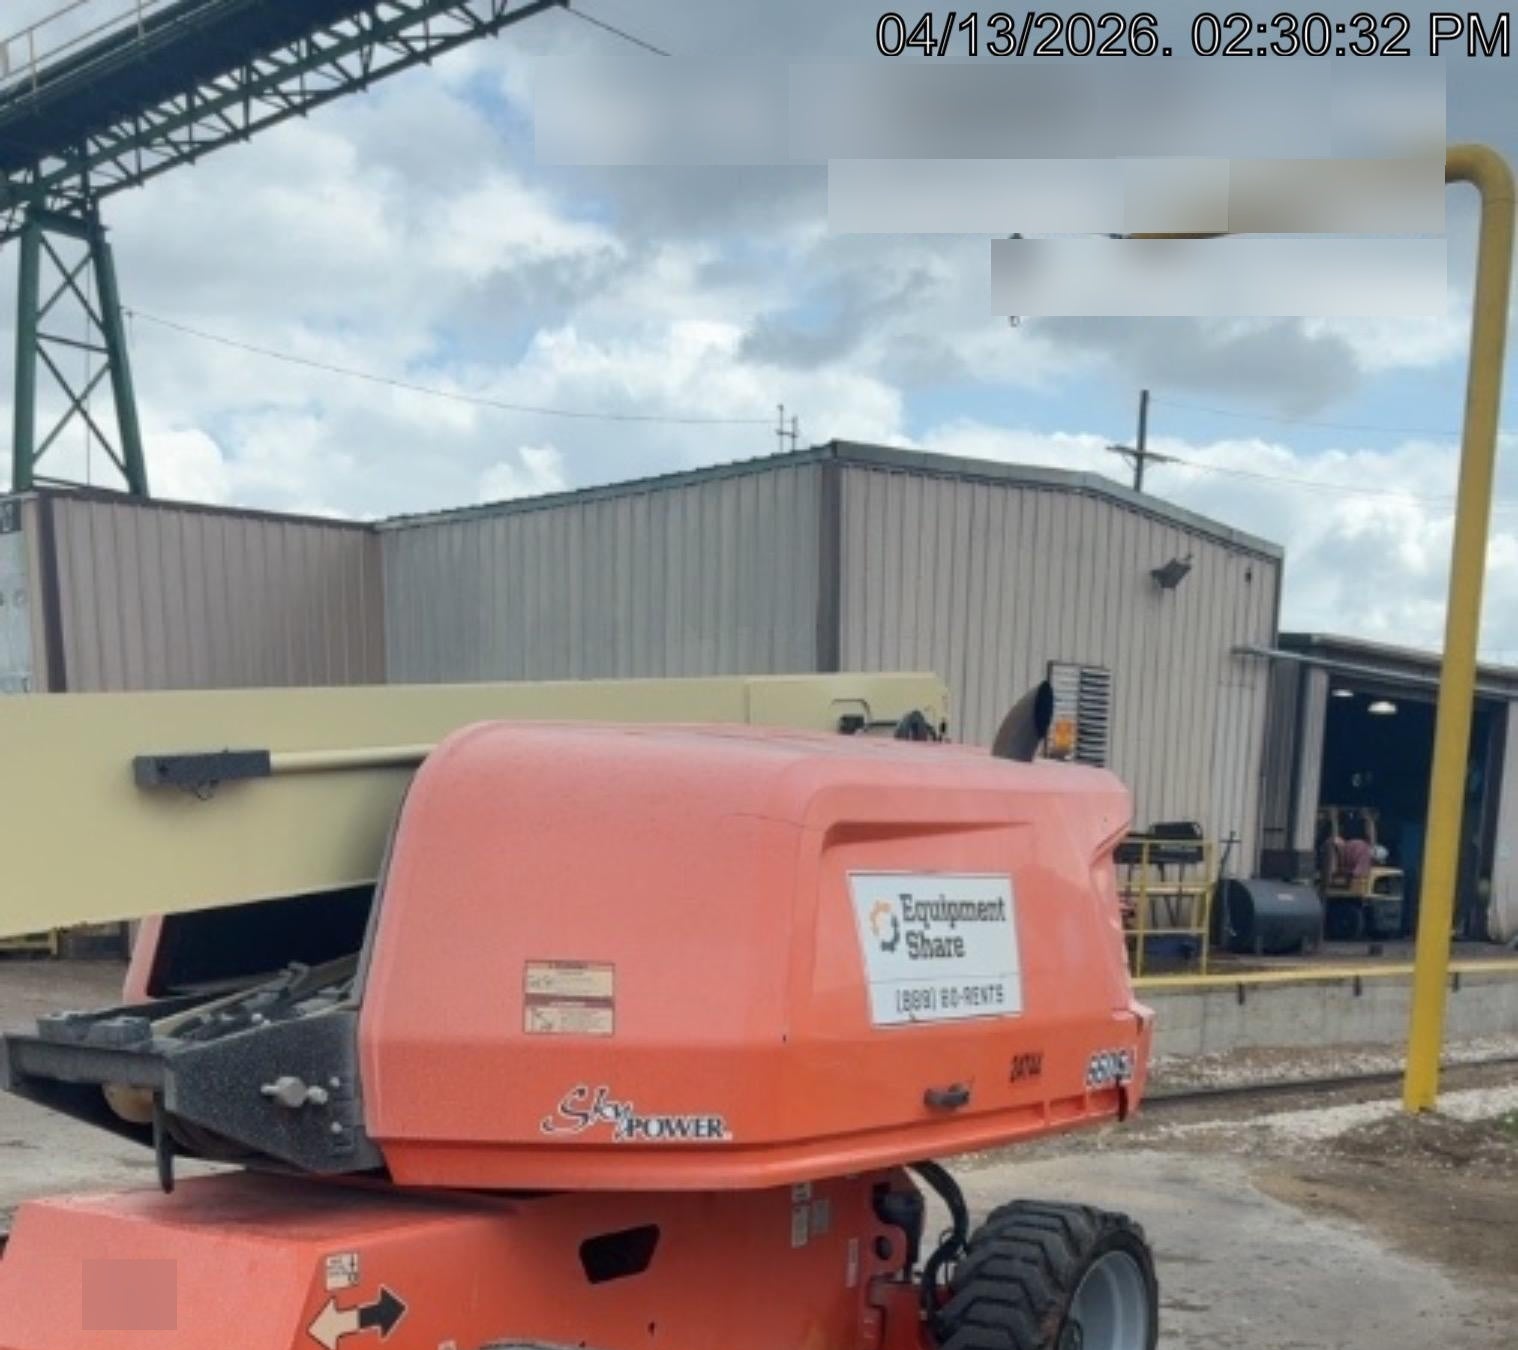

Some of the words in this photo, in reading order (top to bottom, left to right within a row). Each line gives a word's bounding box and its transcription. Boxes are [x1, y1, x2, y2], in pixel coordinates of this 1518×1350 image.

[899, 893, 1005, 929] Equipment
[905, 929, 966, 960] Share
[540, 1086, 634, 1142] Sky
[624, 1116, 726, 1140] POWER
